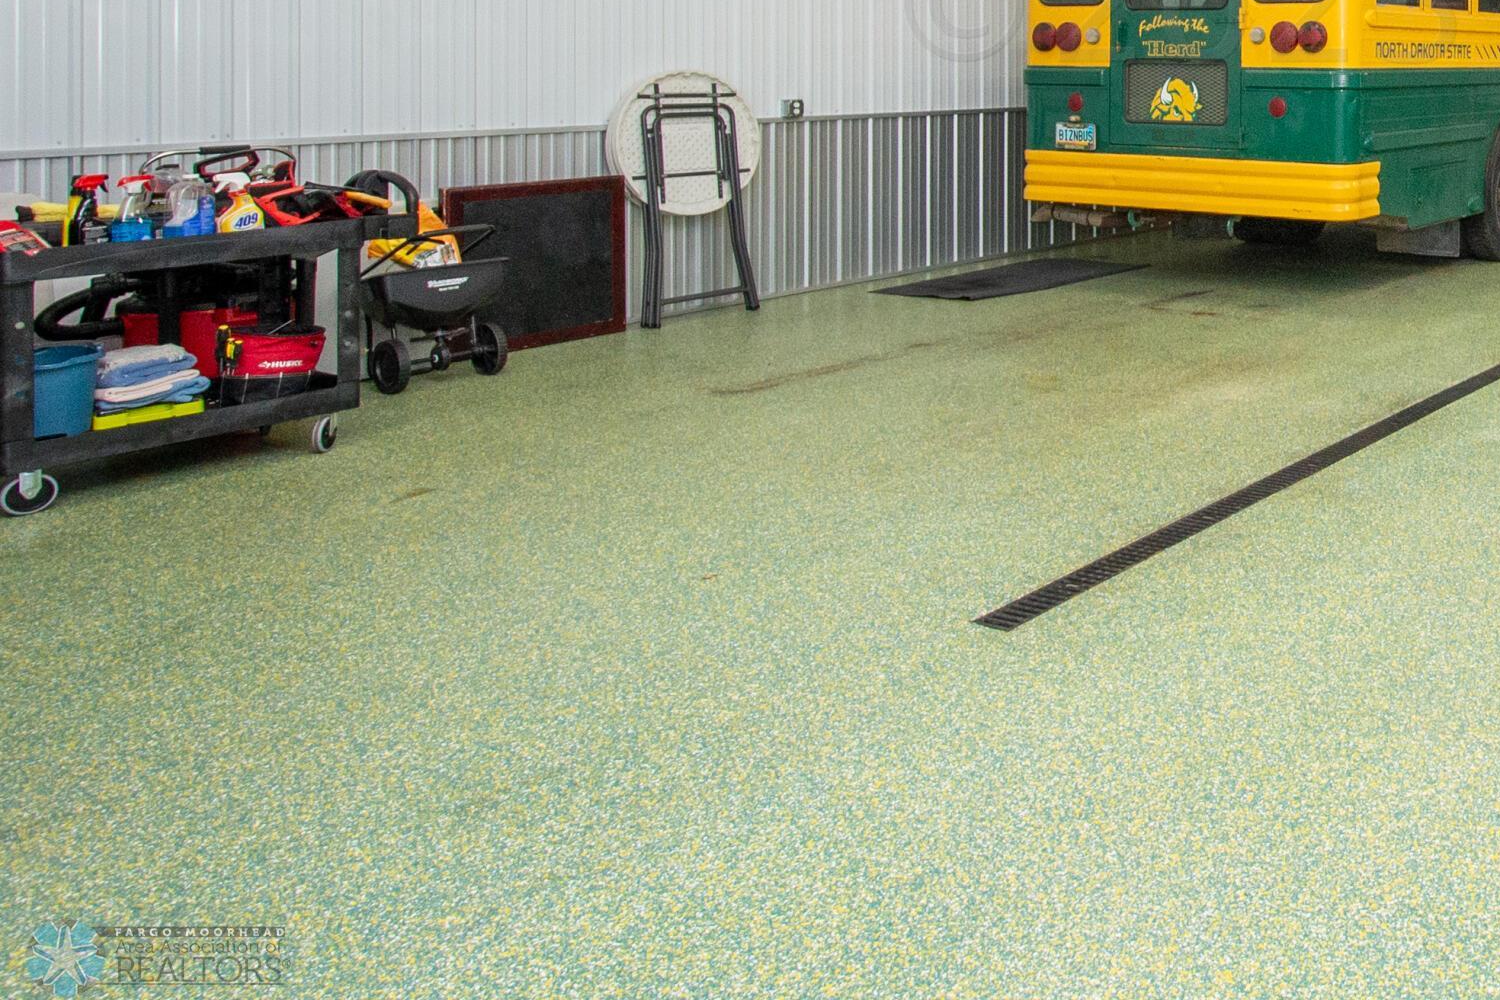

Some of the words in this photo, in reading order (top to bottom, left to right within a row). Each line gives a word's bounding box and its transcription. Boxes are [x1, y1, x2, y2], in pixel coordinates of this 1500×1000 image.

[1138, 14, 1190, 38] Following
[1190, 17, 1210, 34] the
[1375, 41, 1409, 59] NORTH
[1410, 42, 1445, 59] DAKOTA
[1447, 44, 1472, 60] STATE
[235, 212, 259, 229] 409
